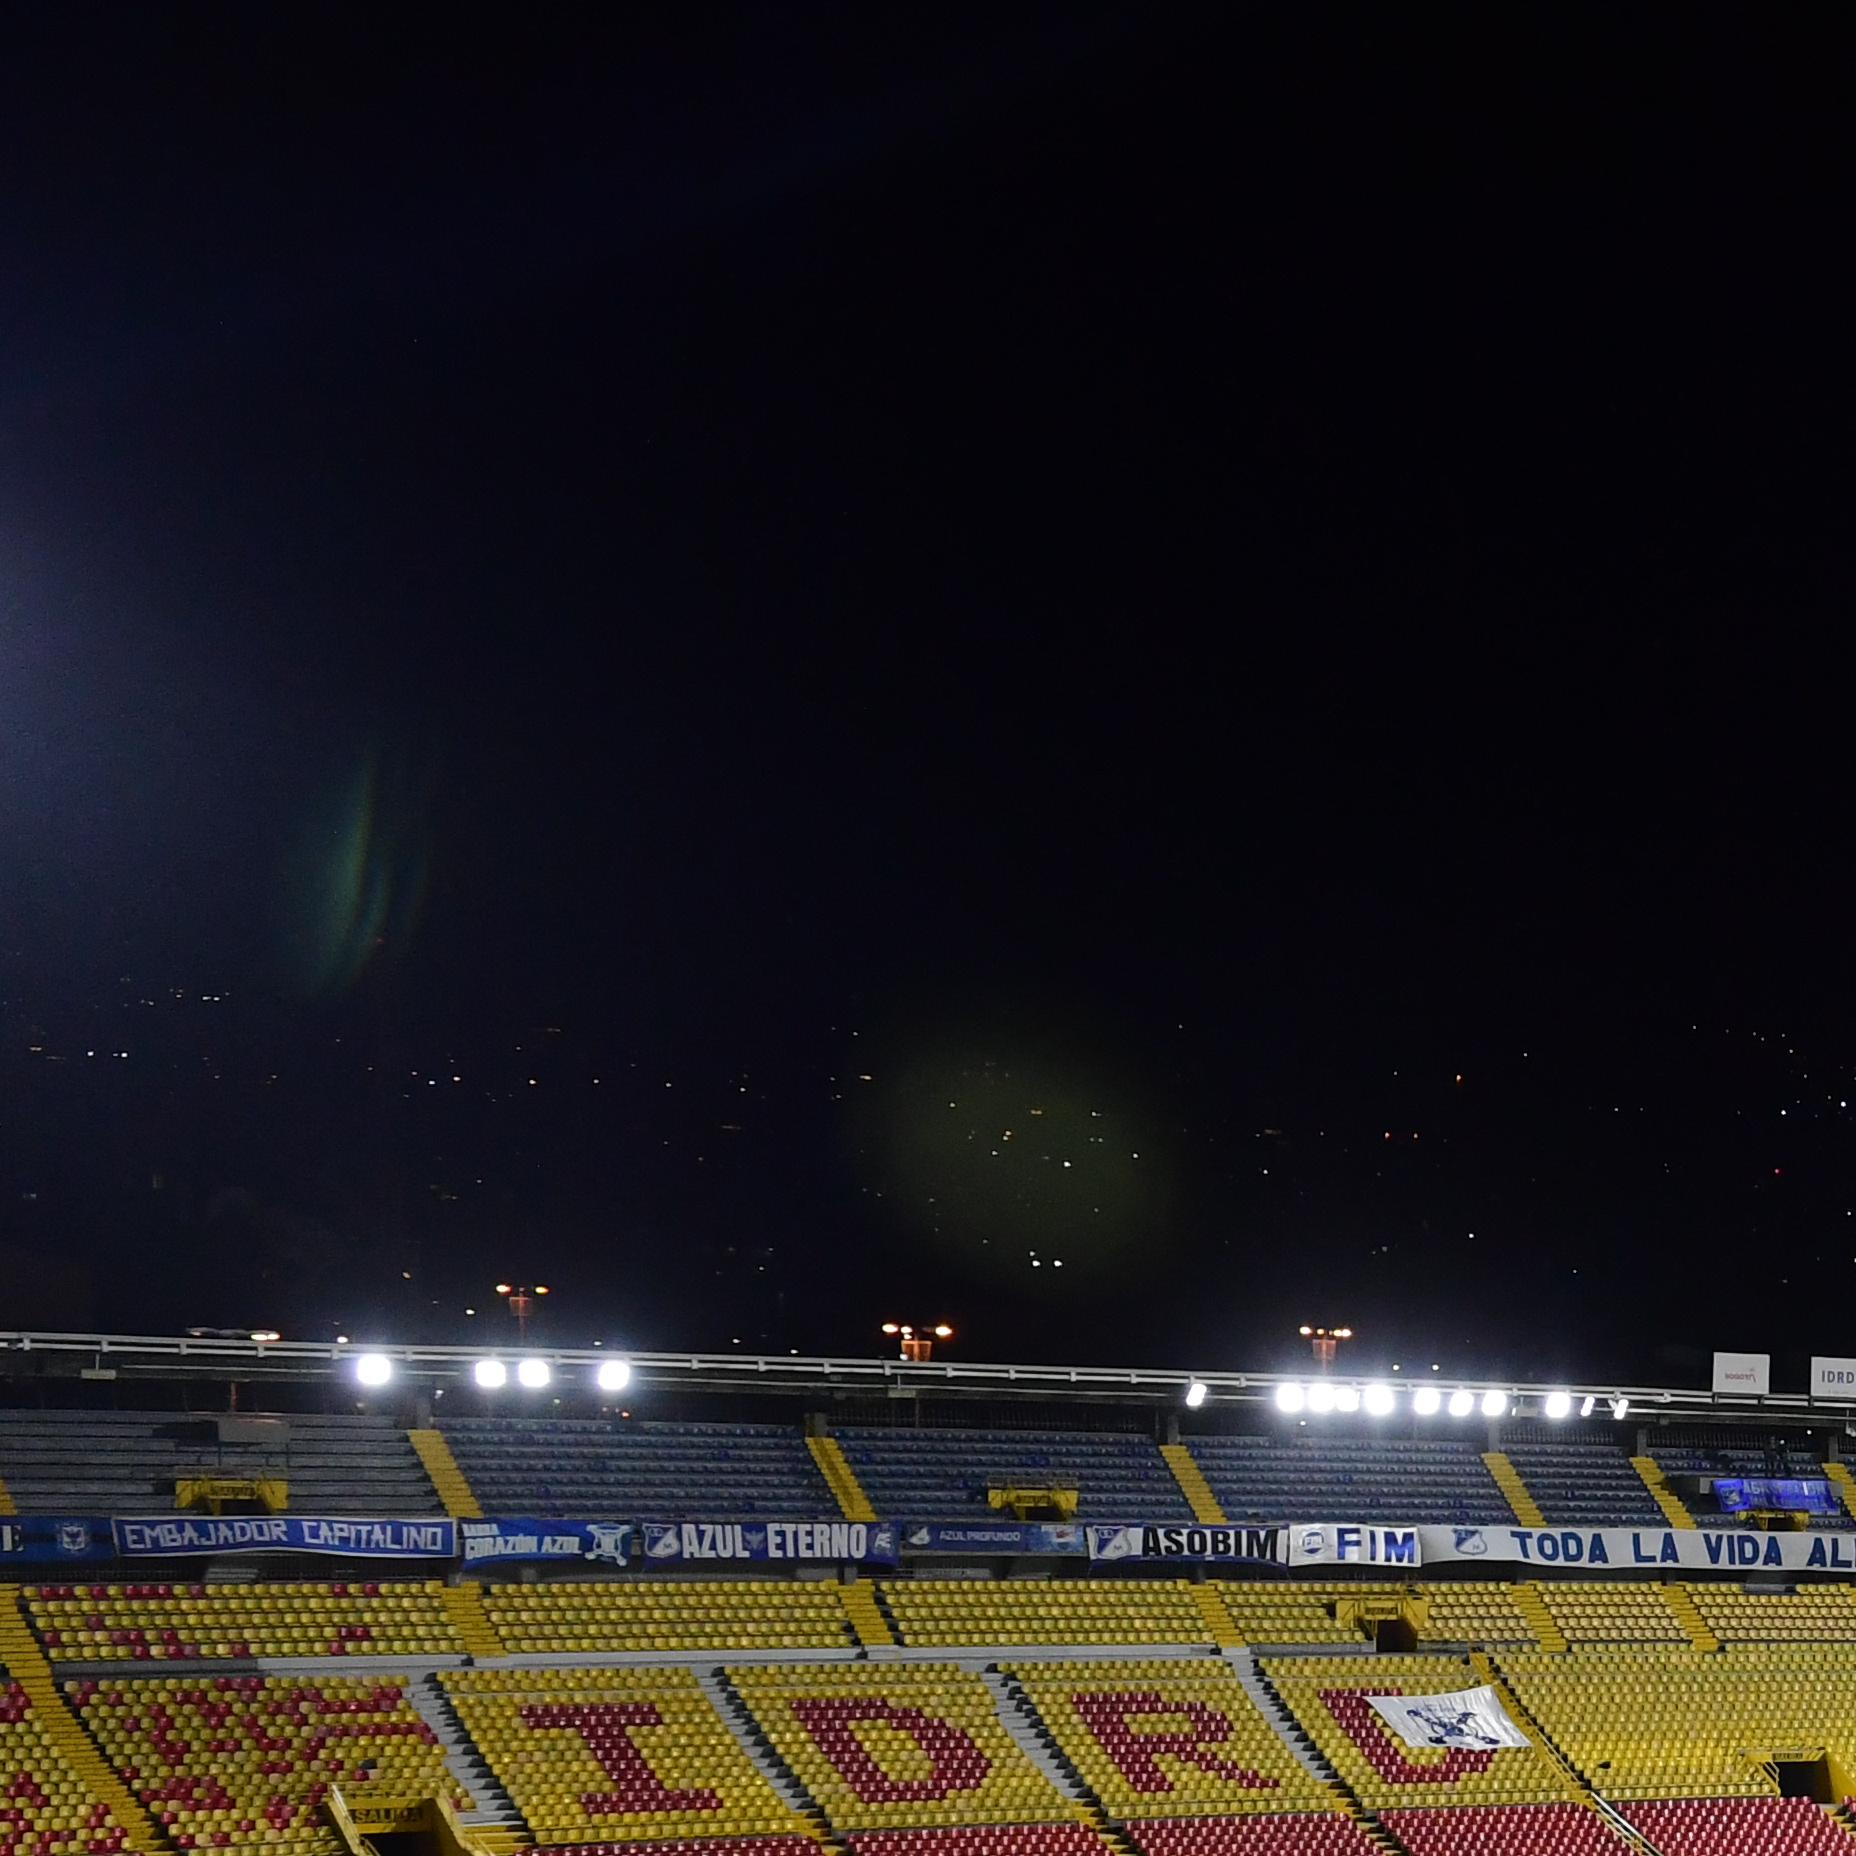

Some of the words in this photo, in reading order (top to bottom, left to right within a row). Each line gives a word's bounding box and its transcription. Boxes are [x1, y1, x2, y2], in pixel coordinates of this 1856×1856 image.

[1821, 1370, 1855, 1384] IDRD
[124, 1518, 288, 1551] EMBAJADOR
[303, 1519, 442, 1552] CAPITALINO
[681, 1524, 750, 1559] AZUL
[767, 1524, 867, 1559] ETERNO
[1142, 1528, 1278, 1561] ASOBIM
[1336, 1527, 1415, 1564] FIM
[1511, 1530, 1608, 1564] TODA
[1633, 1532, 1679, 1565] LA
[1702, 1533, 1783, 1567] VIDA
